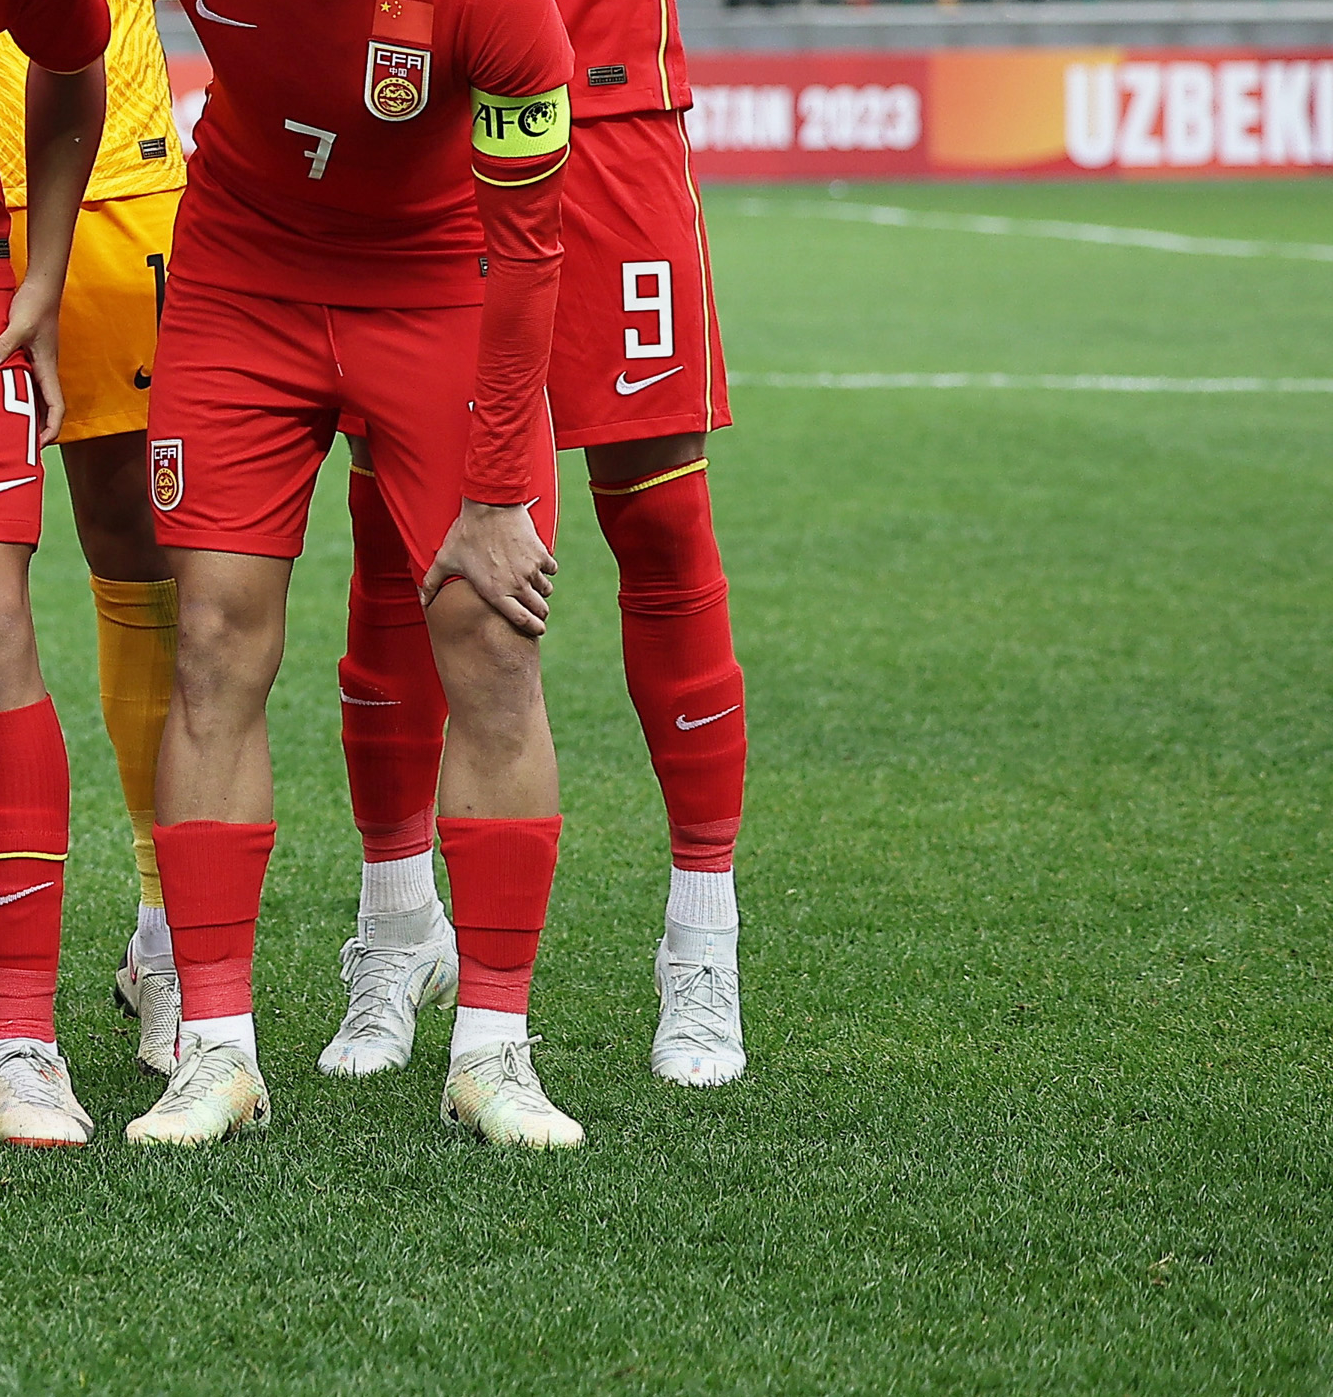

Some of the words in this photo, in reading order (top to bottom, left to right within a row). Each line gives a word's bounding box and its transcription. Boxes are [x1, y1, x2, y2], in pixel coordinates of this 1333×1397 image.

[376, 50, 422, 70] CFA
[472, 101, 550, 140] AFC
[284, 118, 337, 180] 7
[147, 253, 166, 332] 1
[620, 260, 675, 360] 9
[154, 447, 177, 460] CFA
